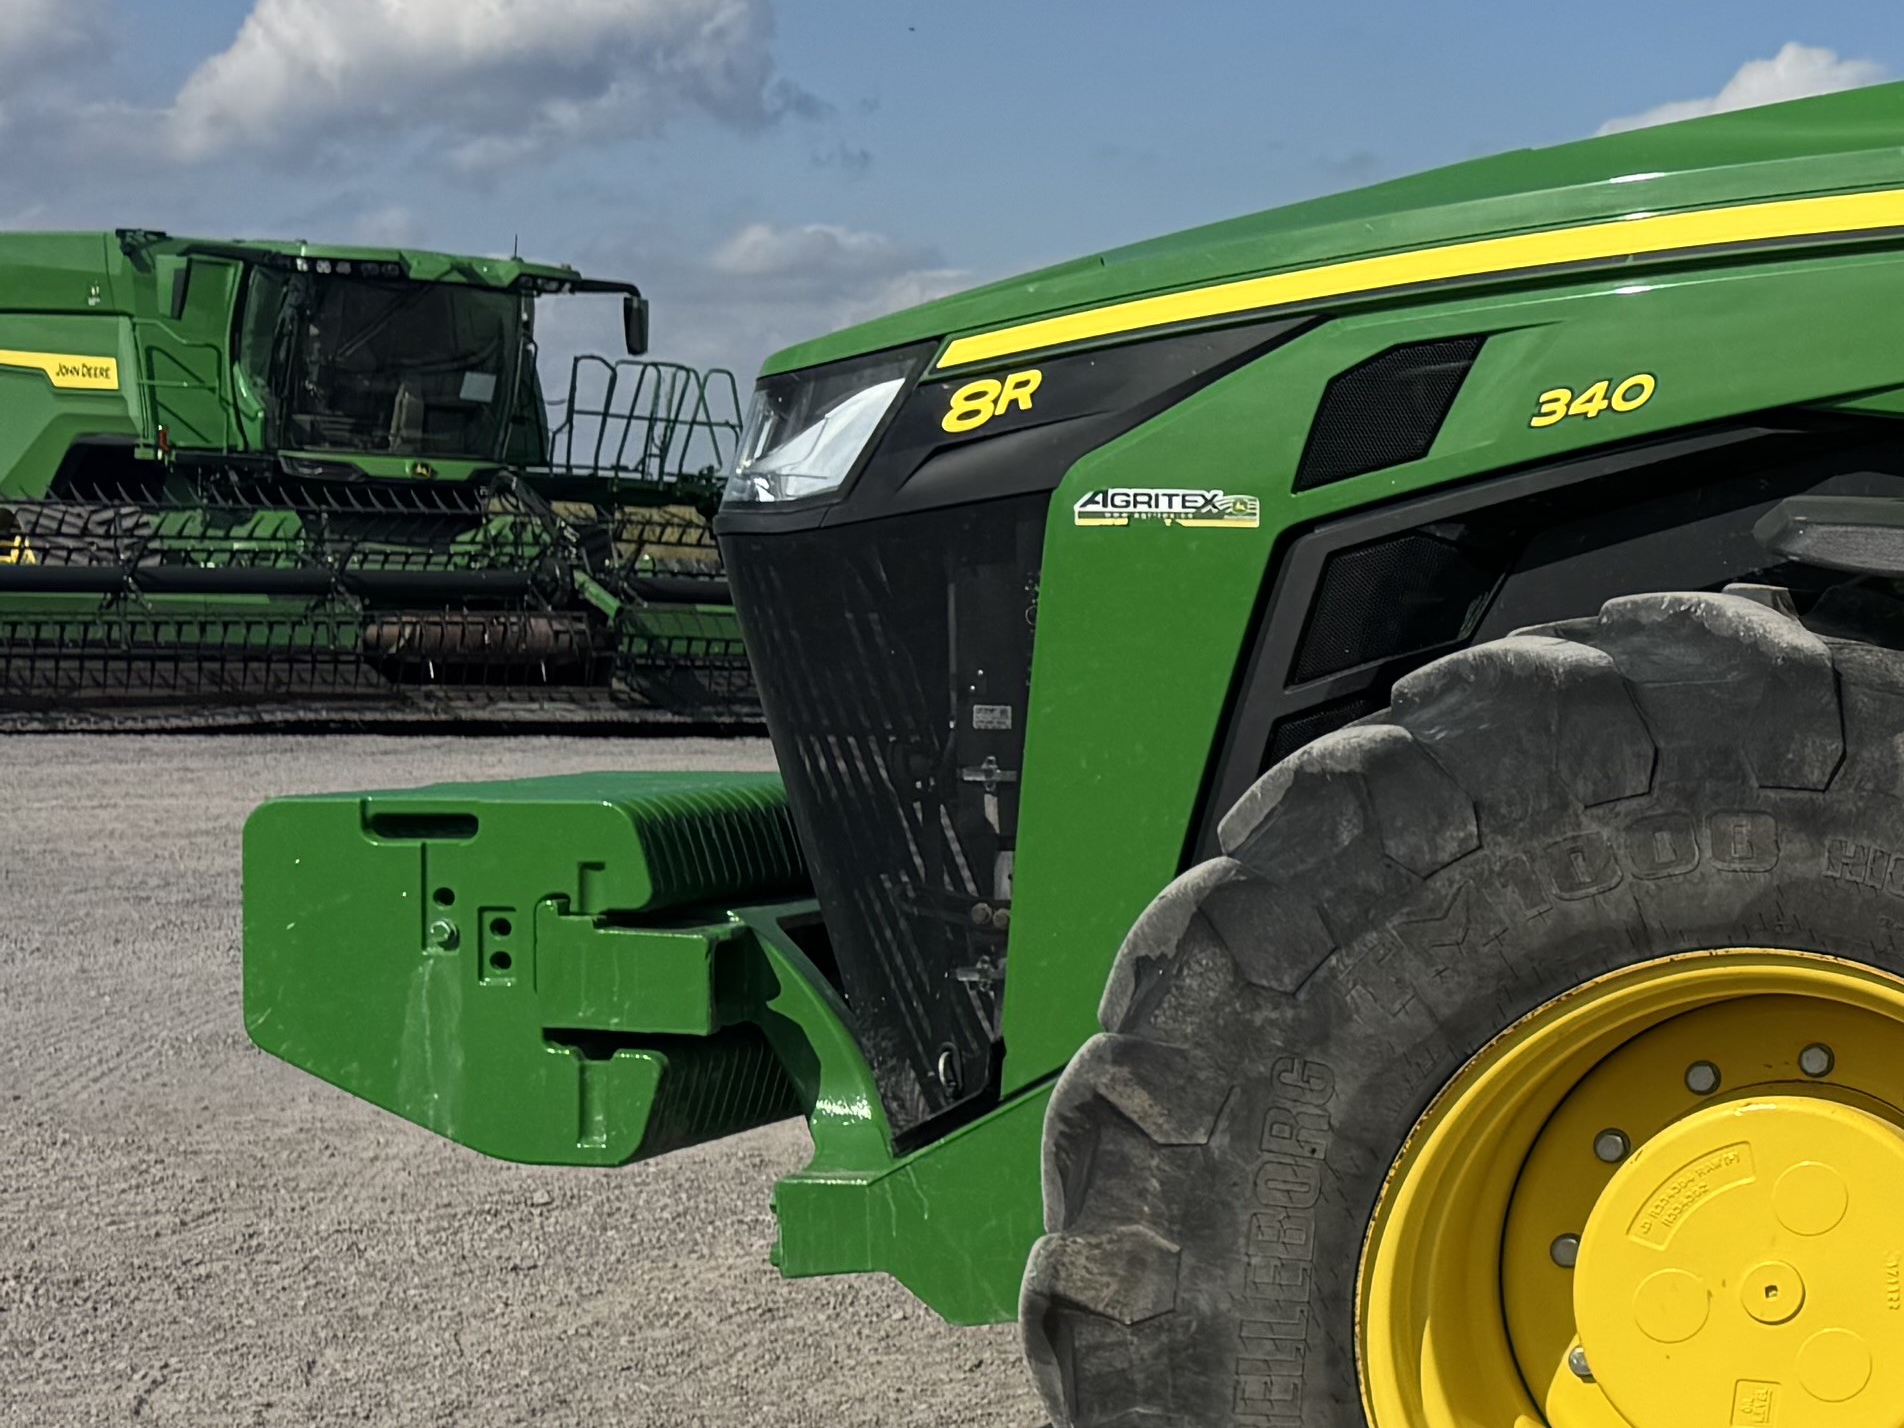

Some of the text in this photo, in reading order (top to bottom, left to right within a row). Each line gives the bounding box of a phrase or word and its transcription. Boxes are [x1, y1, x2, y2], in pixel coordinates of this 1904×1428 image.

[56, 362, 111, 379] JOHN DEERE
[939, 368, 1043, 434] 8R
[1527, 372, 1656, 429] 340
[1079, 489, 1221, 512] AGRITEX
[1342, 808, 1782, 1018] TM1000
